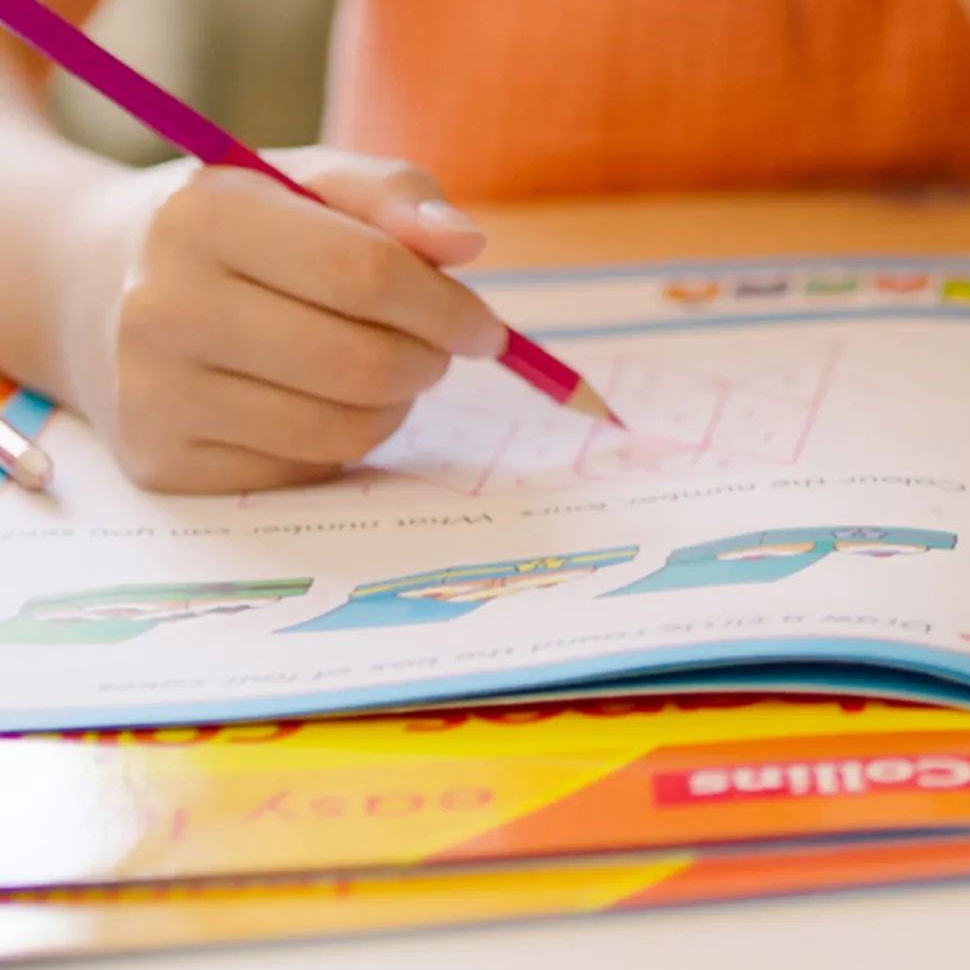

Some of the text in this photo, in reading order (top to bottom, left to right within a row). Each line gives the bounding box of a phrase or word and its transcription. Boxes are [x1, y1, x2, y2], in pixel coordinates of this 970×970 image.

[627, 483, 756, 504] number
[252, 520, 381, 535] number
[395, 512, 493, 528] What
[240, 786, 496, 826] easy
